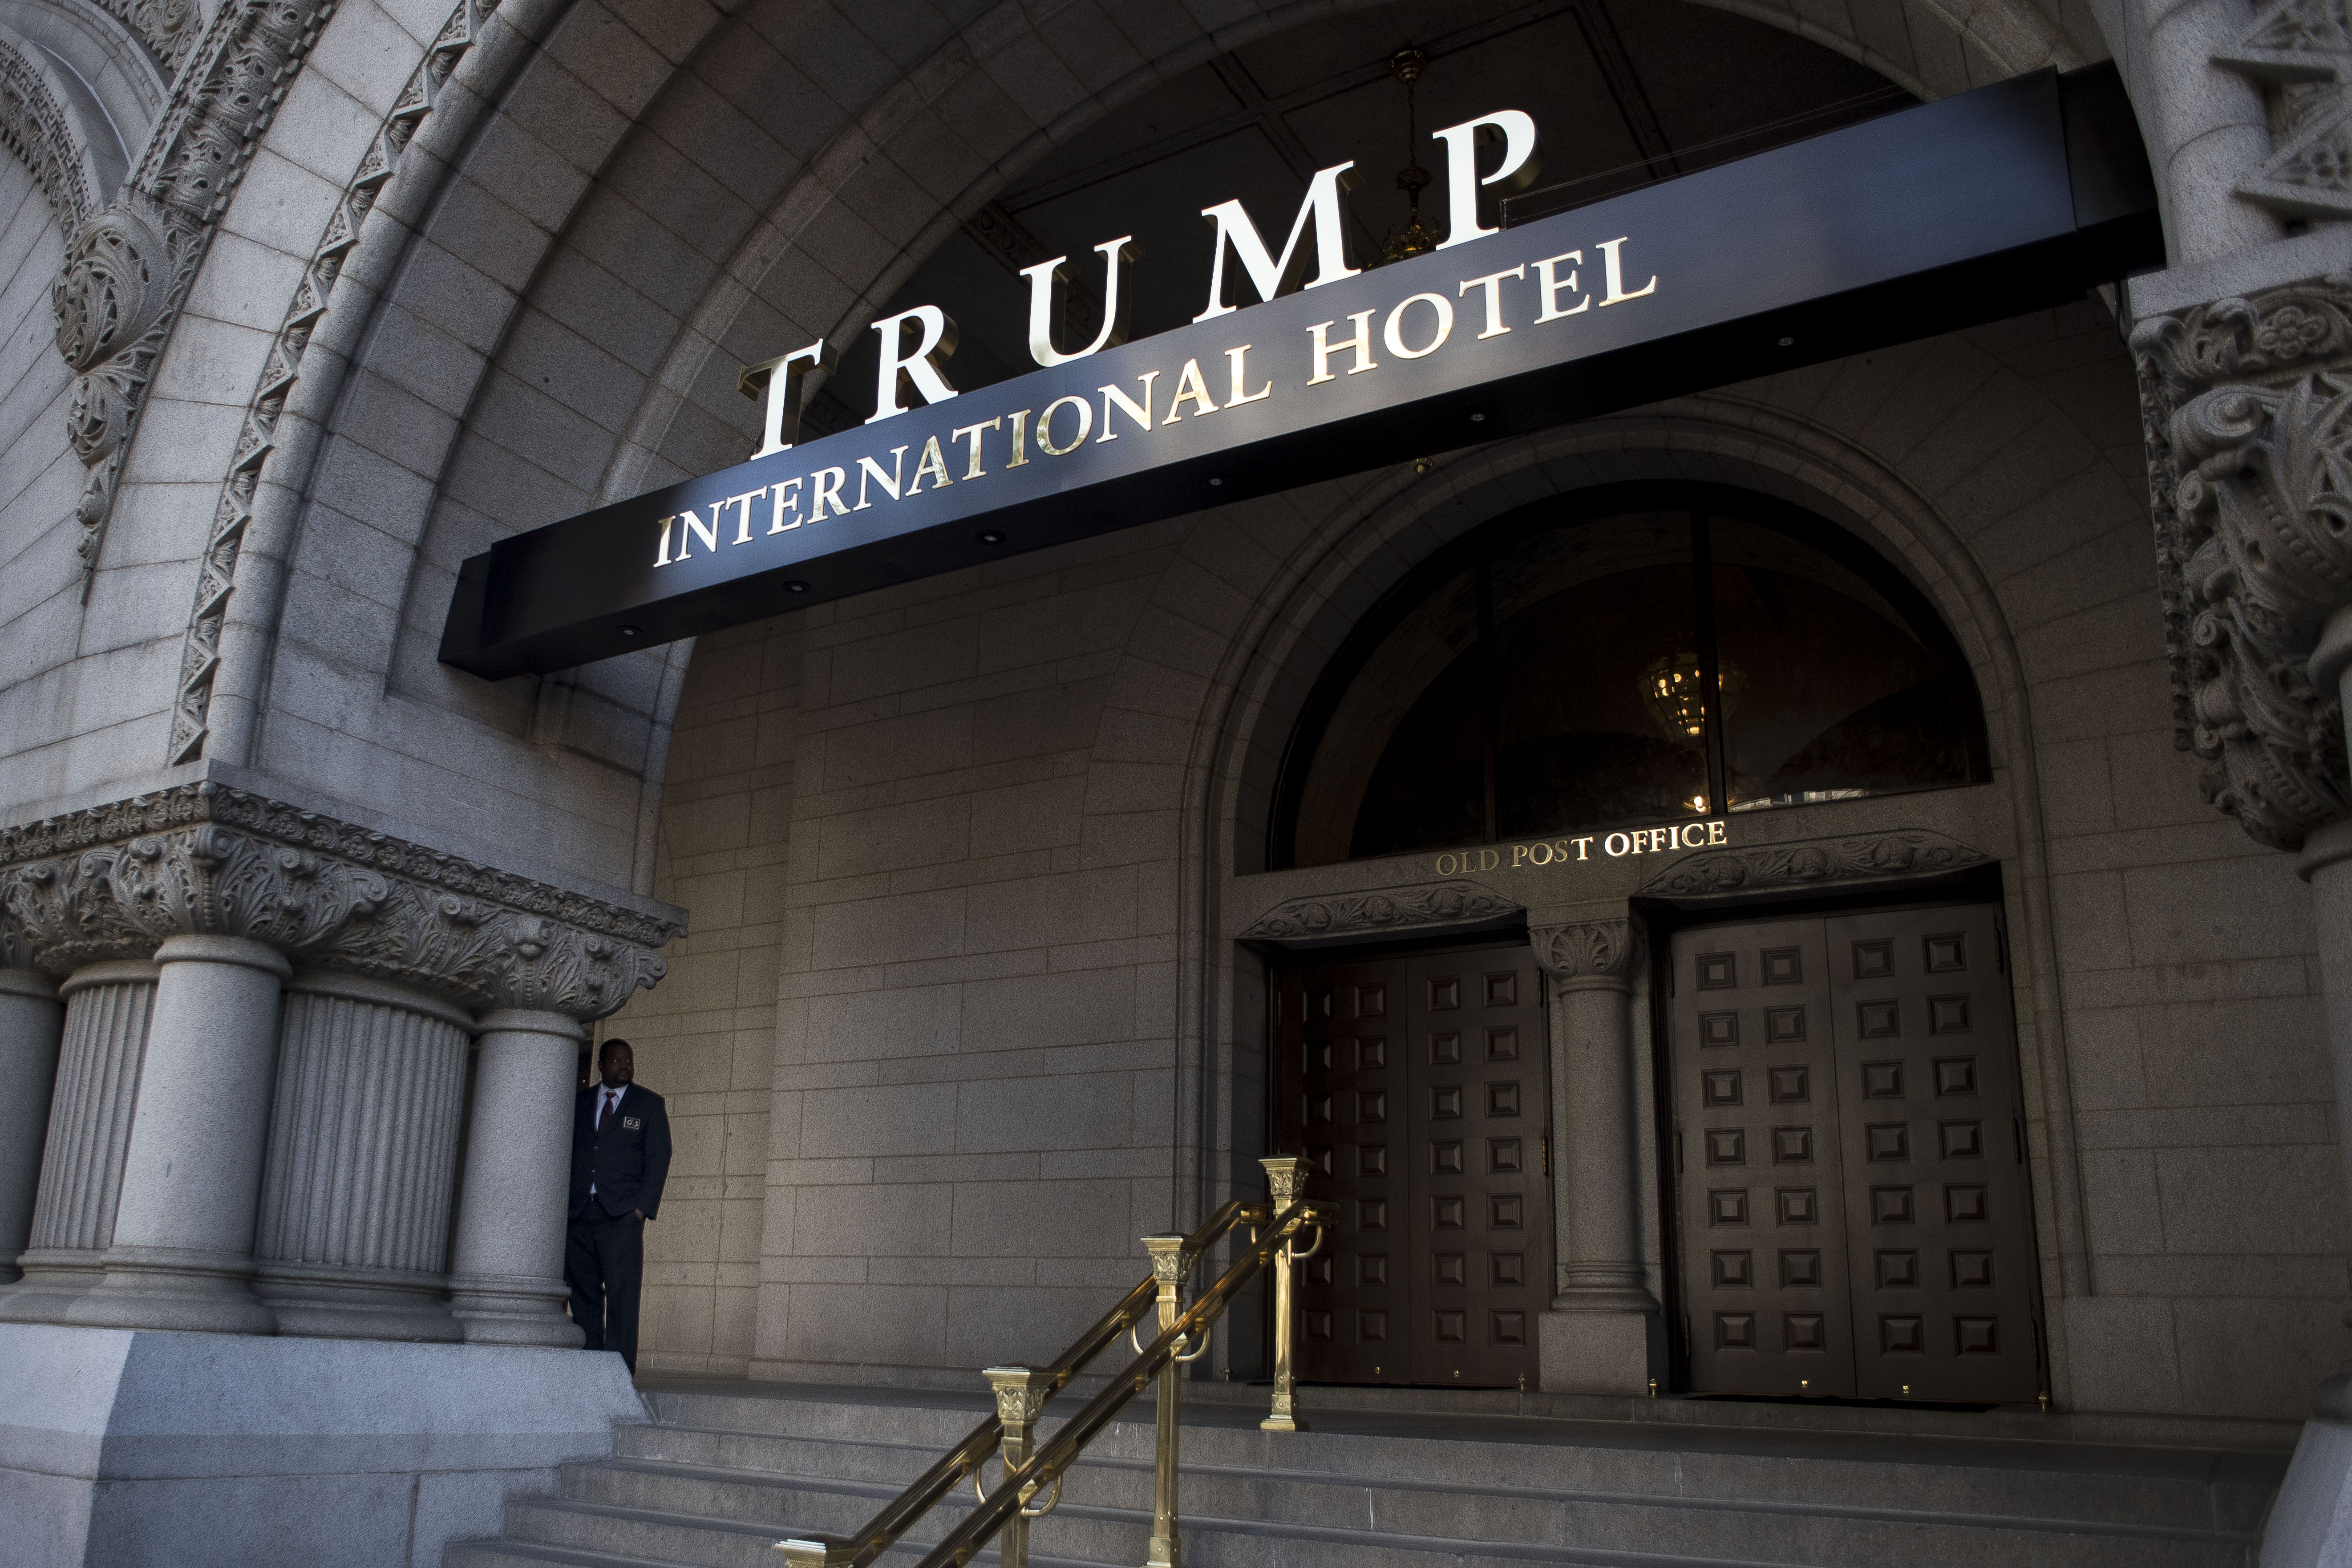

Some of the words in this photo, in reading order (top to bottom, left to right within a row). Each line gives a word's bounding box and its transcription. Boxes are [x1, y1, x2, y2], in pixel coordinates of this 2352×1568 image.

[653, 344, 1272, 568] INTERNATIONAL
[1306, 236, 1657, 387] HOTEL
[737, 109, 1538, 461] TRUMP
[1435, 849, 1500, 875] OLD
[1511, 836, 1594, 867] POST
[1604, 821, 1727, 856] OFFICE
